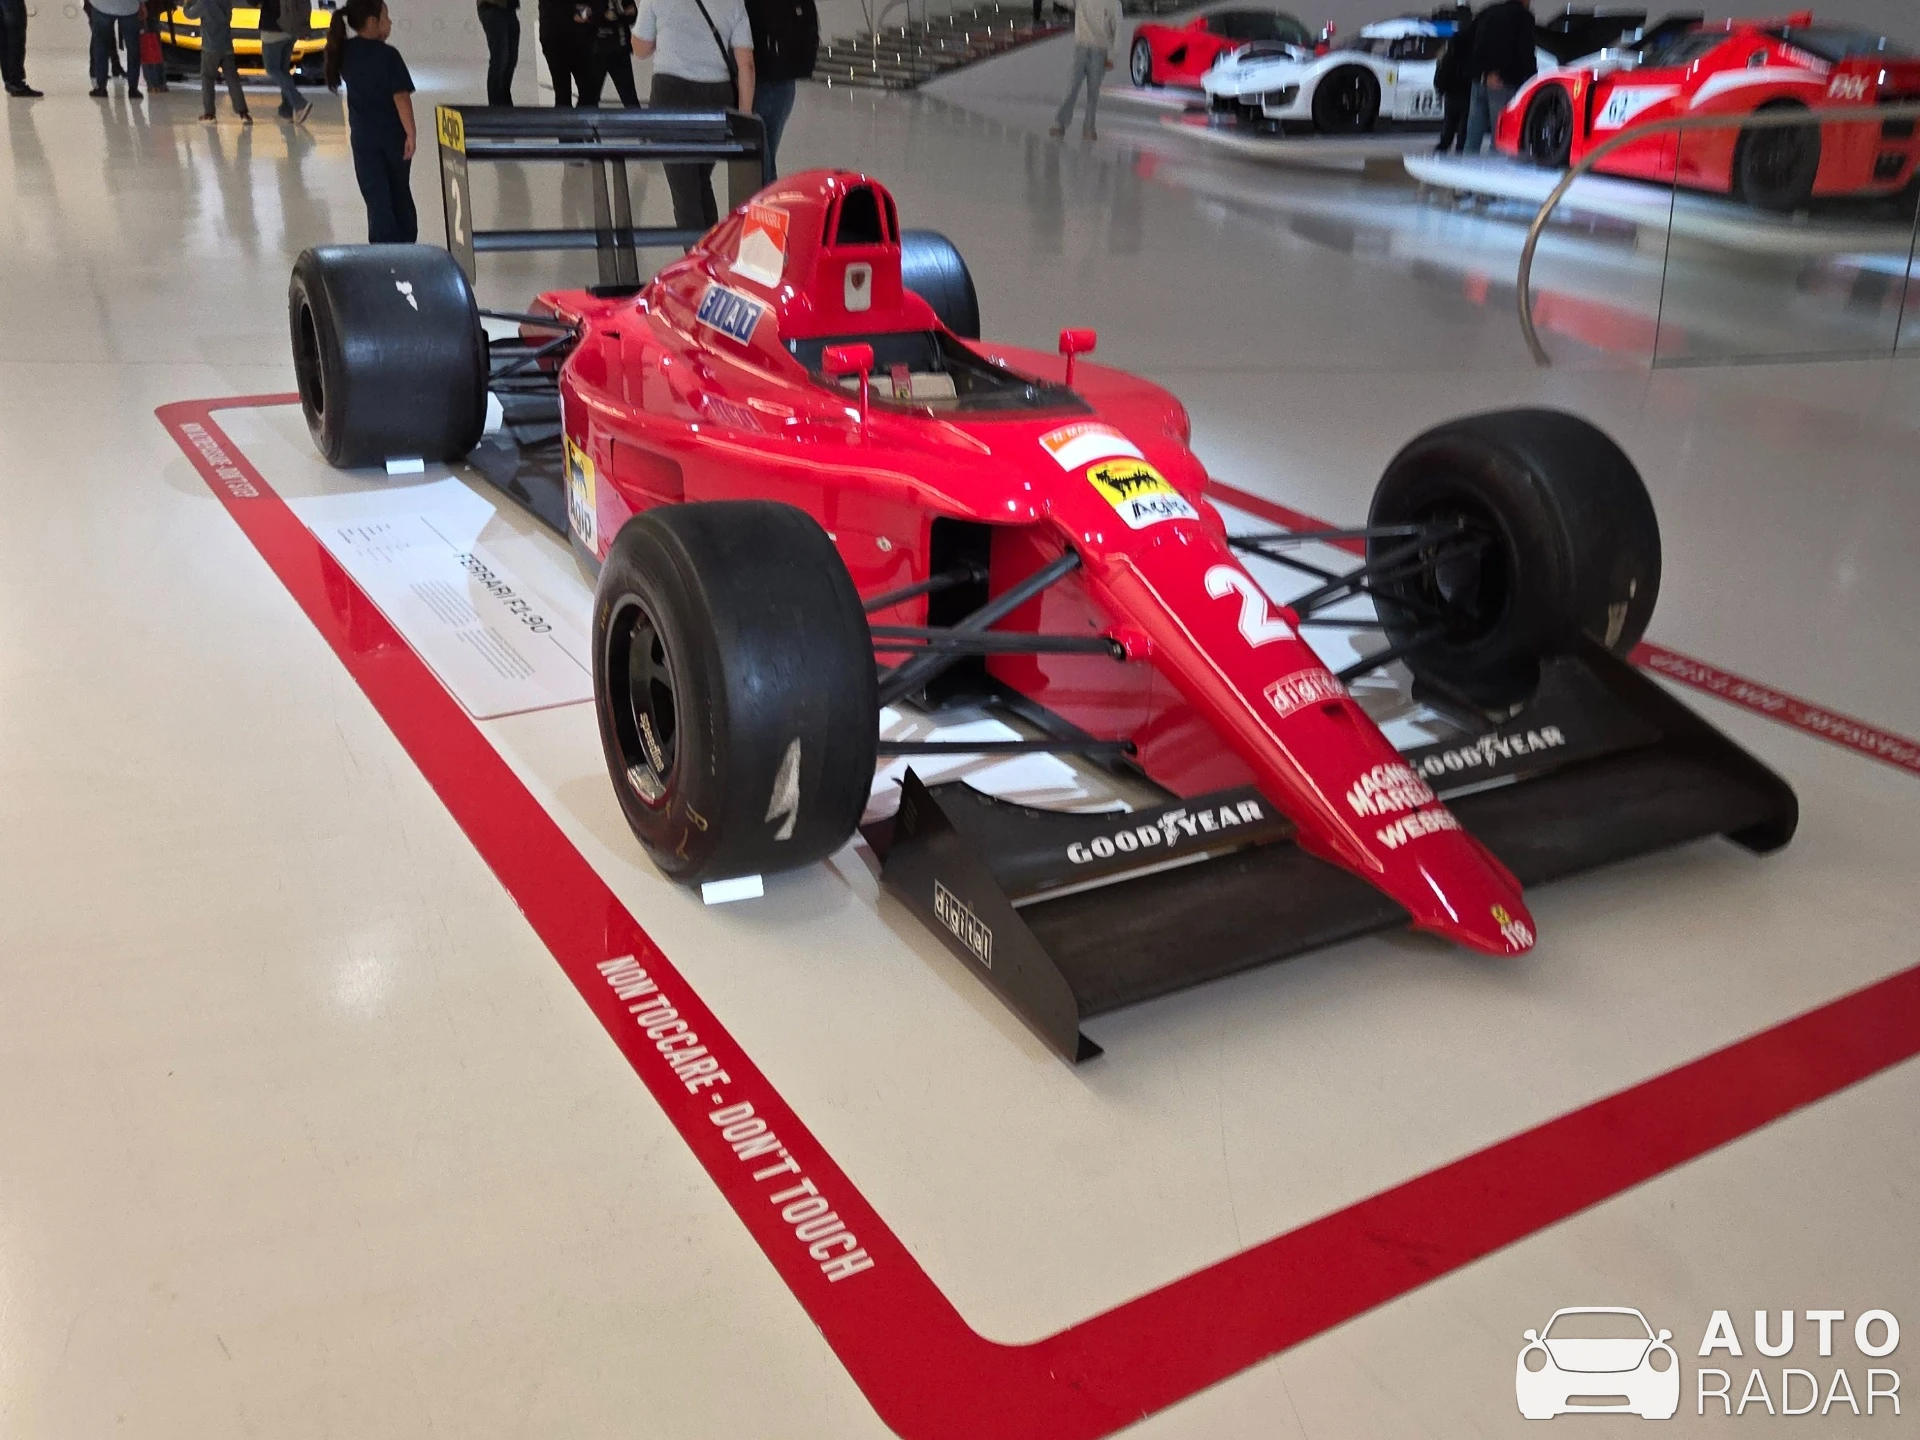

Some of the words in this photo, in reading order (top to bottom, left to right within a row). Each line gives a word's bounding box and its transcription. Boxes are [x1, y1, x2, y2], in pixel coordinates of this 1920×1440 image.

[451, 177, 465, 245] 2
[701, 289, 759, 336] FIAT
[570, 486, 592, 543] Agip
[453, 552, 517, 599] FERRARI
[1204, 564, 1297, 649] 2
[936, 887, 990, 963] digital
[597, 955, 656, 1000] NON
[629, 993, 731, 1095] TOCCARE
[711, 1092, 723, 1105] -
[709, 1101, 800, 1181] DON'T
[770, 1178, 875, 1282] TOUCH
